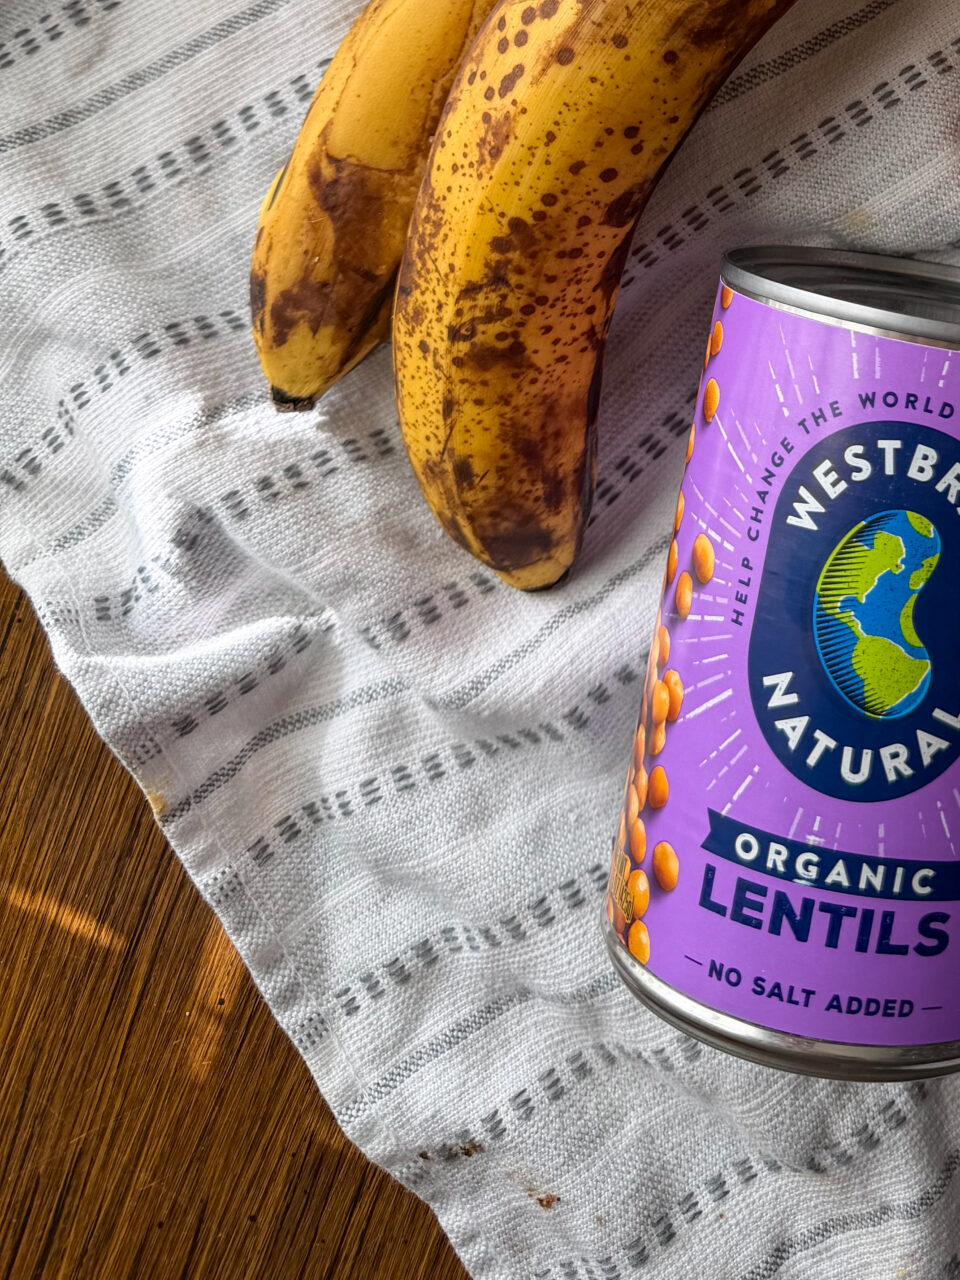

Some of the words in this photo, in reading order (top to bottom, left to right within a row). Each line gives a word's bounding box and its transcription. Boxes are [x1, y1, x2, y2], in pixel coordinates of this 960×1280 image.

[730, 556, 754, 627] HELP
[746, 436, 795, 542] CHANGE
[797, 400, 844, 435] THE
[858, 391, 955, 420] WORLD
[734, 831, 938, 895] ORGANIC
[698, 863, 952, 958] LENTILS
[707, 959, 743, 988] NO
[751, 975, 816, 1009] SALT
[824, 993, 915, 1019] ADDED
